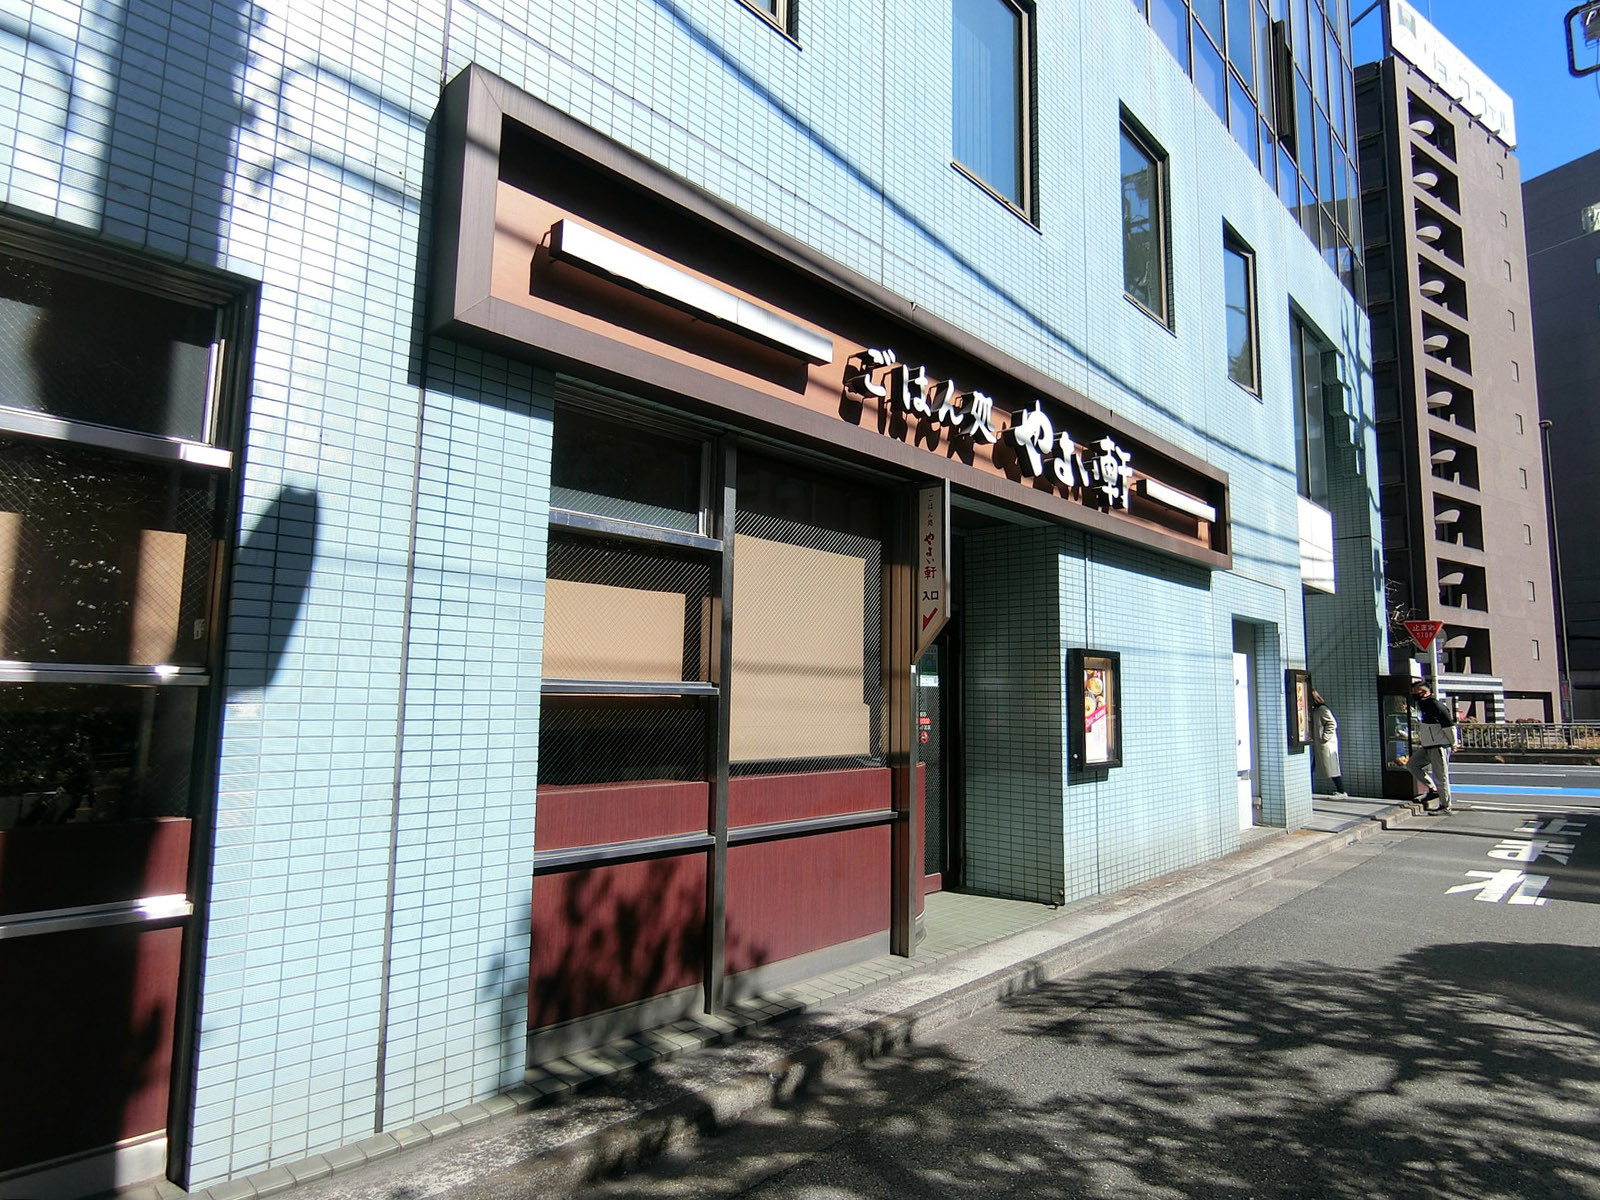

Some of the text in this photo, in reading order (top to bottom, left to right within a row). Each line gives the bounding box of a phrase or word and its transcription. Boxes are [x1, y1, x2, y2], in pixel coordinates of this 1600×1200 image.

[864, 348, 1134, 510] ごはん処 やよい軒
[923, 532, 937, 580] やよい軒
[922, 590, 939, 601] 入口
[1411, 623, 1436, 632] 止まれ
[1416, 631, 1433, 639] STOP
